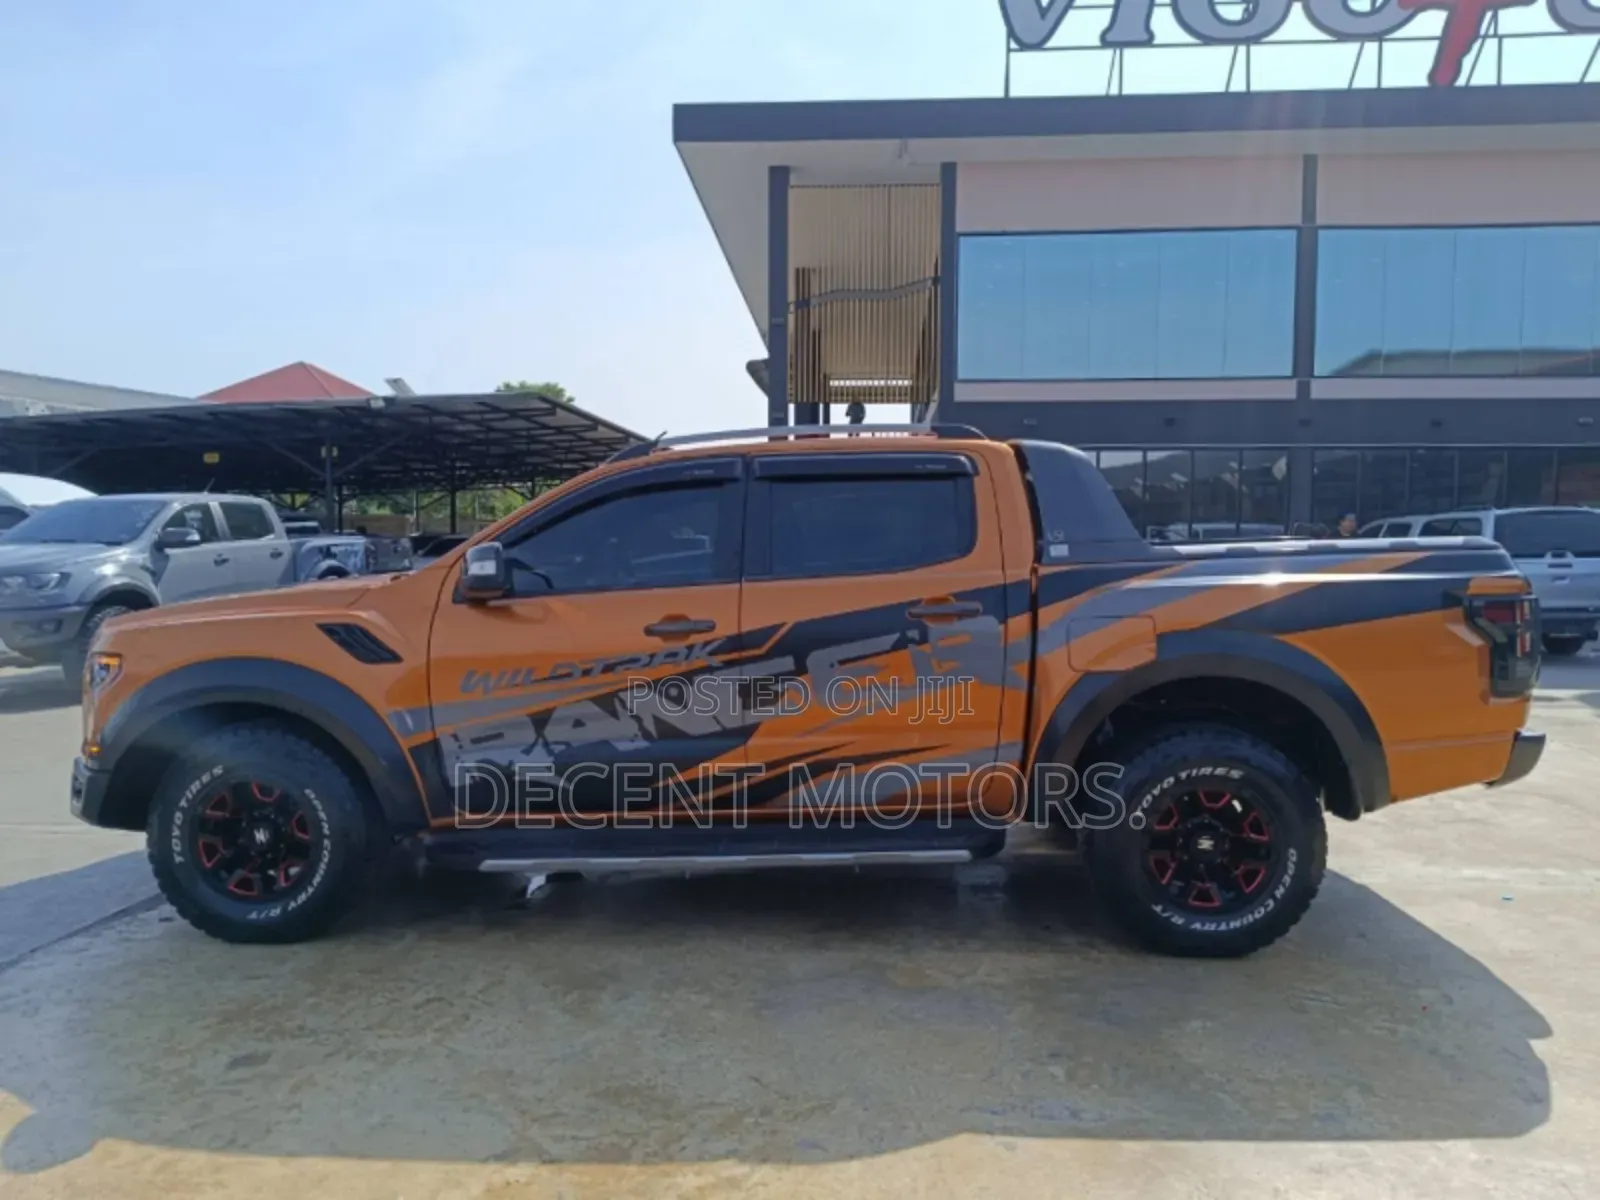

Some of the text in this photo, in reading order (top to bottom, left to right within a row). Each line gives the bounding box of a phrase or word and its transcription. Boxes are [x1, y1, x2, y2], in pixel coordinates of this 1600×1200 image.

[458, 637, 728, 694] WILDTRAK
[1178, 765, 1247, 781] TIRES
[171, 764, 225, 865] TOYO TIRES
[1274, 848, 1298, 899] OPEN
[1190, 898, 1276, 932] COUNTRY
